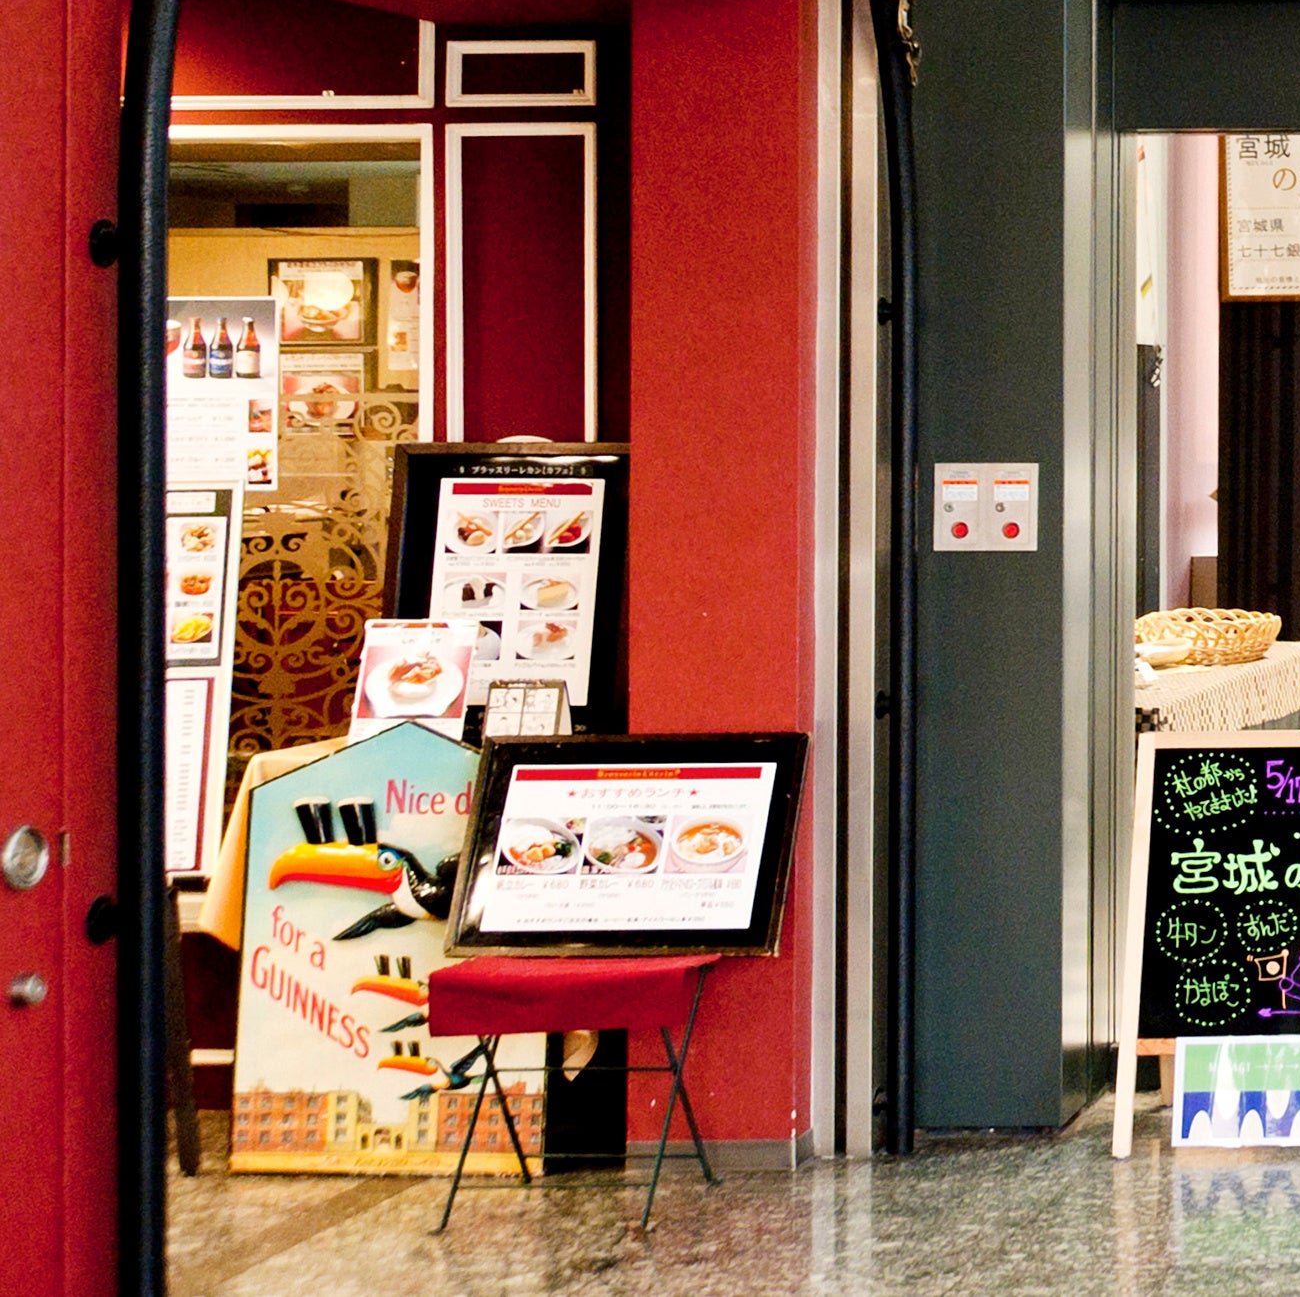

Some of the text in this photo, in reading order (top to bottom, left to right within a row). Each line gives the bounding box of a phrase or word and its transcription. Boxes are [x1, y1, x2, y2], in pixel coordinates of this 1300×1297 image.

[1237, 133, 1290, 159] 宮城
[1237, 218, 1284, 233] 宮城県
[483, 498, 562, 509] SWEETS MENU
[1172, 758, 1246, 798] 杜の都から
[385, 777, 471, 815] Nice d
[271, 905, 326, 971] for a
[1166, 916, 1217, 948] 牛タン
[1243, 912, 1291, 941] ずんだ
[250, 945, 371, 1060] GUINNESS
